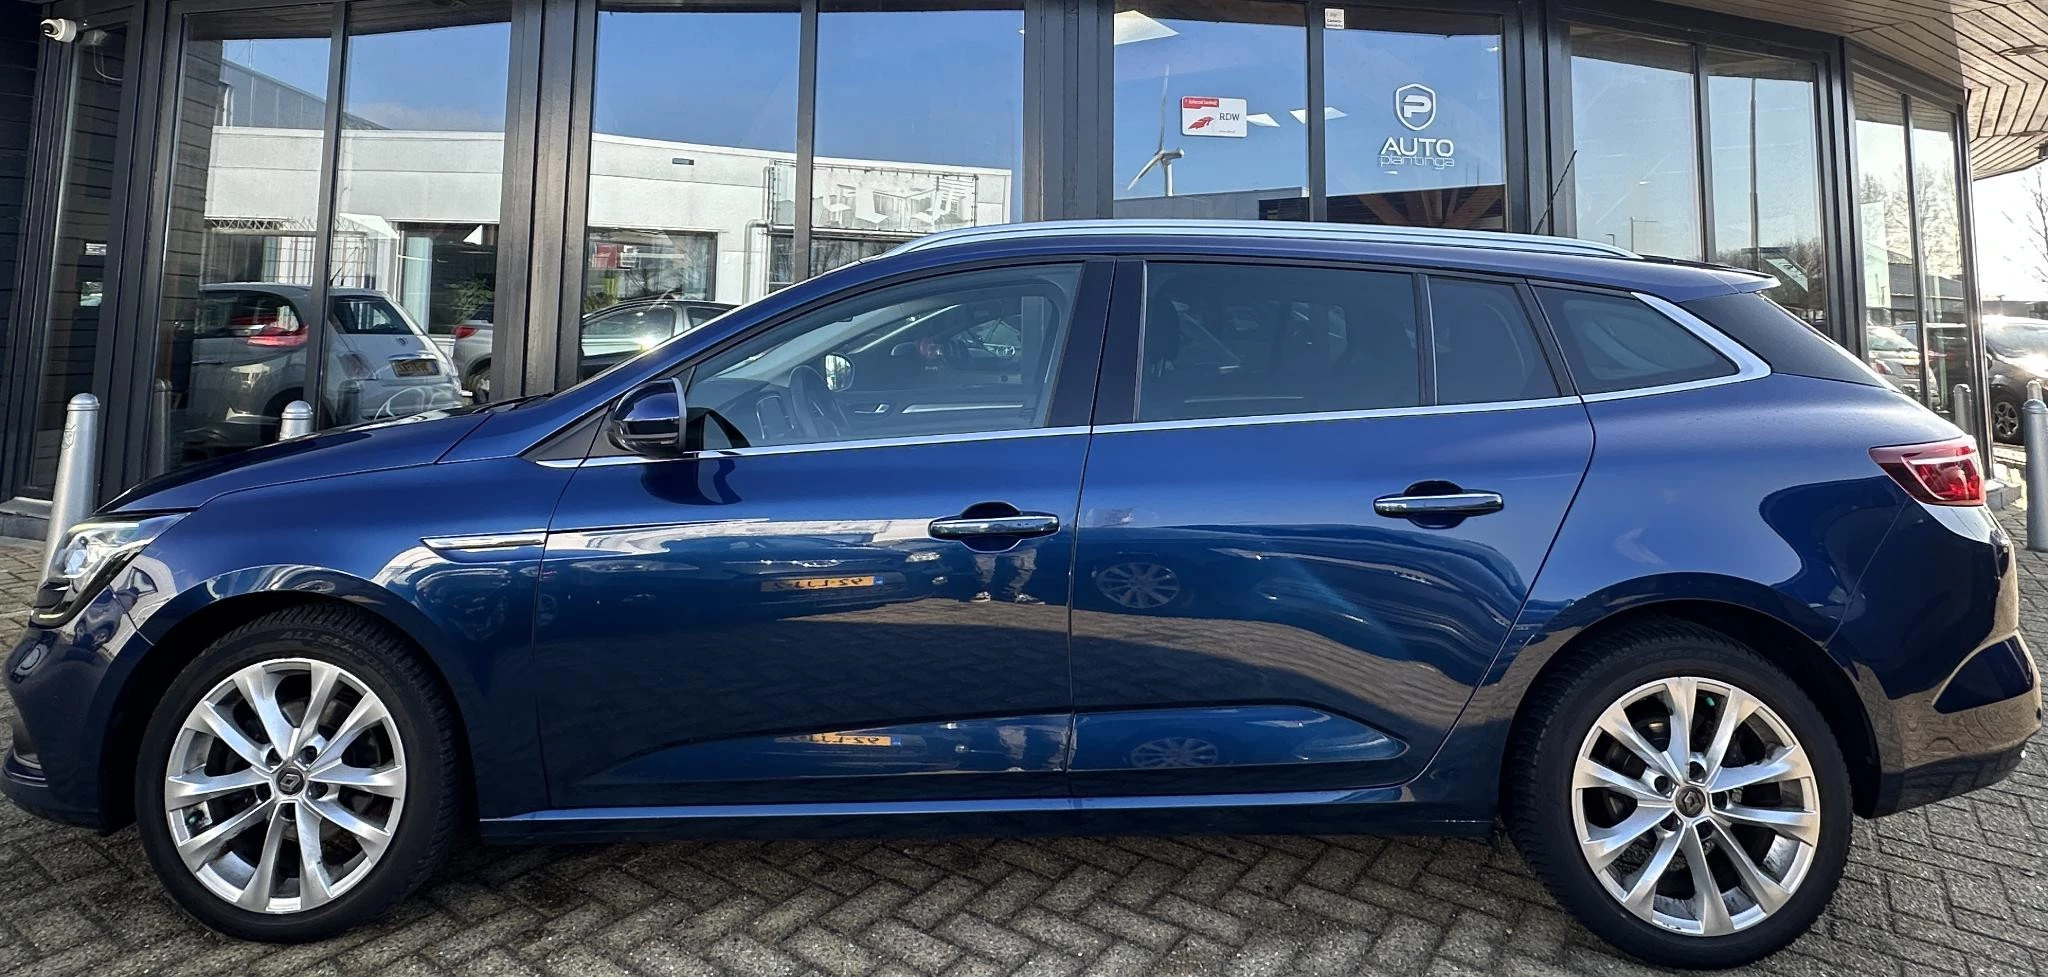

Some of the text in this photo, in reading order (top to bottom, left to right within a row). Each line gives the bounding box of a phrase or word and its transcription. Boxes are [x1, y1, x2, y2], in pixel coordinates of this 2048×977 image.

[1219, 112, 1240, 121] RDW
[1380, 136, 1454, 157] AUTO
[1380, 154, 1455, 170] plantinga
